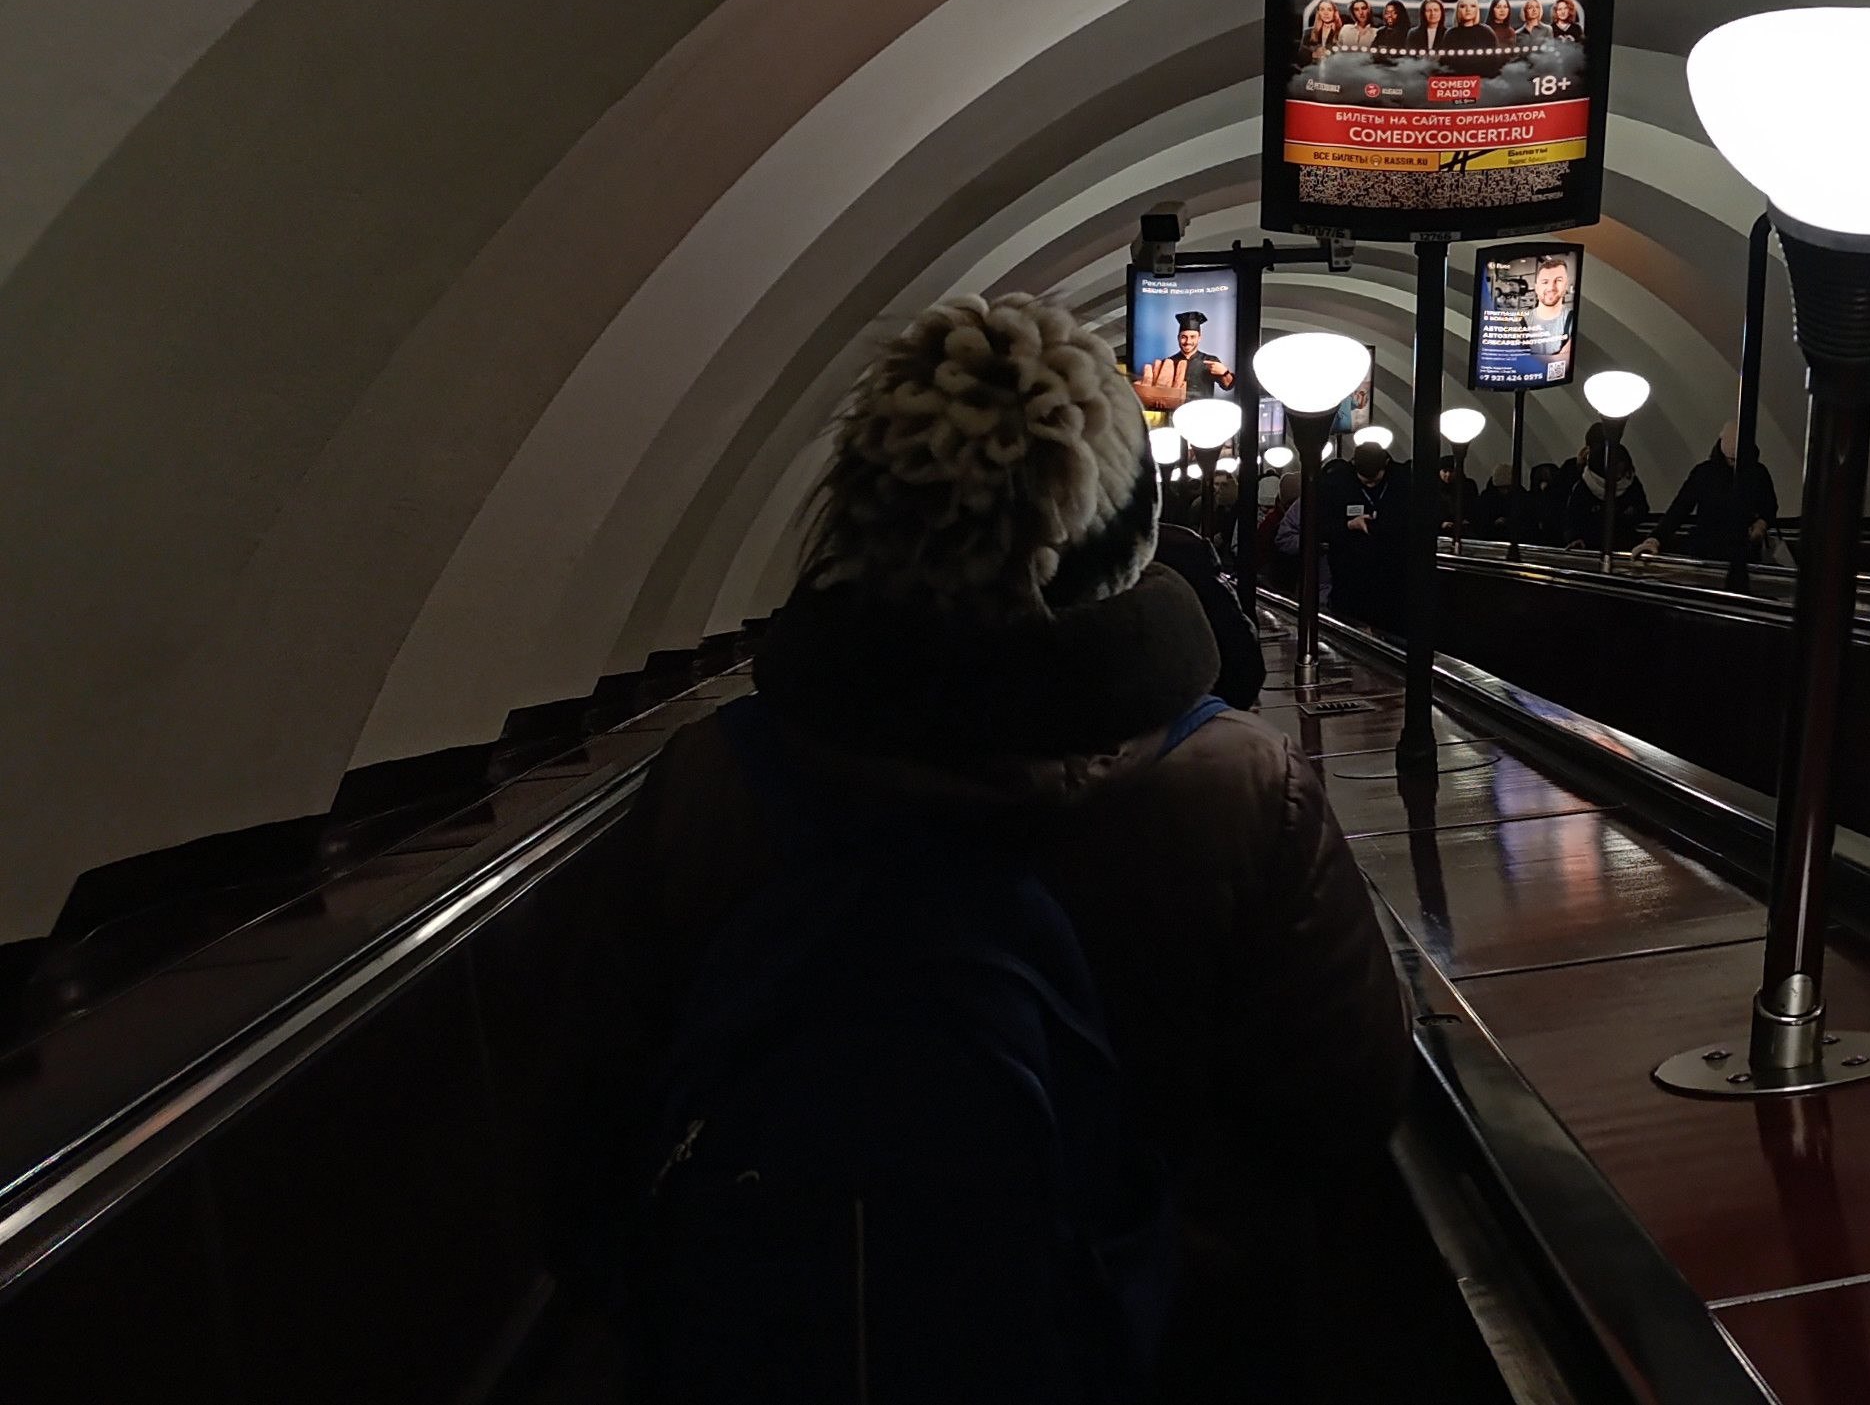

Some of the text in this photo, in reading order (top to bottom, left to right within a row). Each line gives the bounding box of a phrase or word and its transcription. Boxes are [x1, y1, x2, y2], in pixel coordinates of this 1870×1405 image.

[1431, 79, 1477, 89] COMEDY
[1532, 76, 1572, 96] 18+
[1436, 88, 1471, 98] RADIO
[1336, 110, 1546, 126] БИЛЕТЫ НА САЙТЕ ОРГАНИЗАТОРА
[1349, 126, 1534, 144] COMEDYCONCERT.RU
[1313, 151, 1368, 165] ВСЕ БИЛЕТЫ
